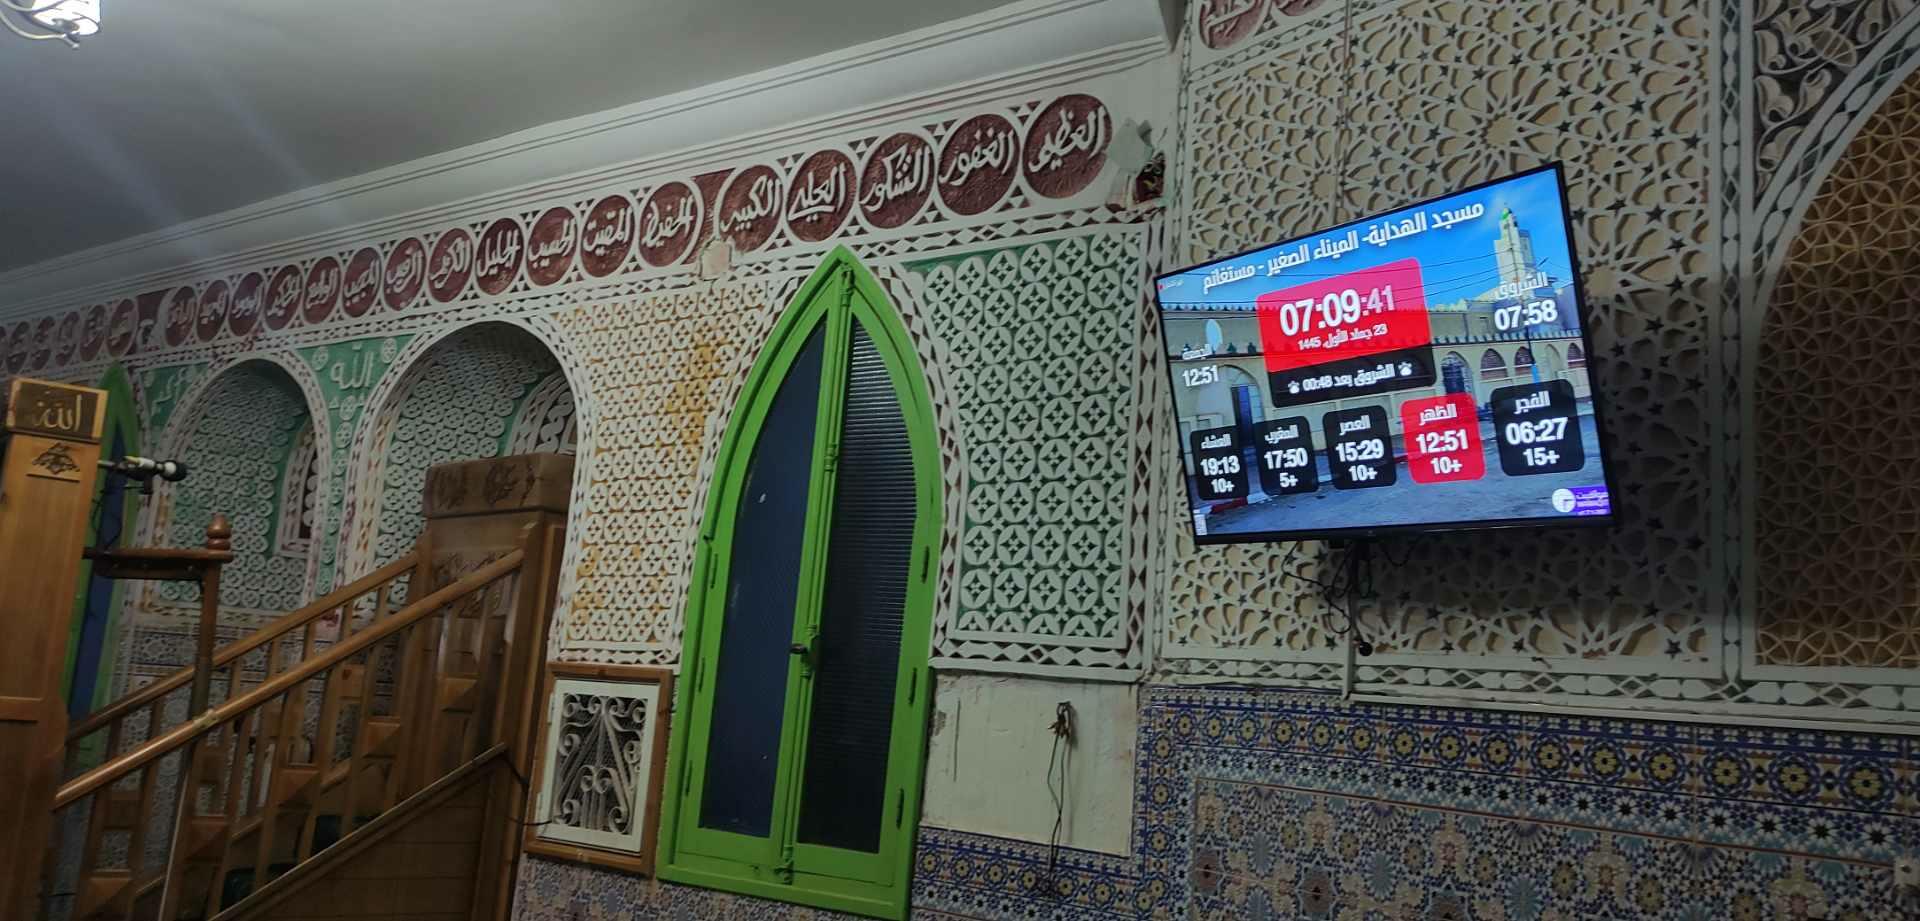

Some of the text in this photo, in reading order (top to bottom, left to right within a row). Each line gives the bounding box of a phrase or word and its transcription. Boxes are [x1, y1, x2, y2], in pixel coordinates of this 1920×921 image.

[938, 126, 1014, 187] الغفور
[787, 161, 847, 223] العلي
[859, 143, 932, 212] الشكور
[719, 174, 783, 233] الكبير
[1431, 202, 1485, 230] مسجد
[582, 205, 633, 257] المقيت
[1313, 230, 1360, 260] الميناء
[476, 228, 521, 278] الجليل
[1265, 244, 1310, 277] الصغير
[1202, 262, 1256, 296] مستغانم
[1494, 272, 1549, 302] الشروق
[1279, 285, 1396, 337] 07:09:41
[1493, 299, 1559, 332] 07:58
[1297, 336, 1322, 351] 1445
[1372, 323, 1389, 337] 23
[1181, 364, 1219, 388] 12:51
[1302, 363, 1396, 392] الشروق بعد 00:48
[1419, 402, 1458, 426] الظهر
[1513, 390, 1552, 415] الفجر
[1263, 423, 1300, 445] المغرب
[1339, 413, 1372, 436] العصر
[1504, 416, 1569, 446] 06:27
[1200, 432, 1233, 450] العشاء
[1335, 437, 1386, 464] 15:29
[1415, 428, 1469, 454] 12:51
[1199, 454, 1241, 477] 19:13
[1263, 446, 1309, 470] 17:50
